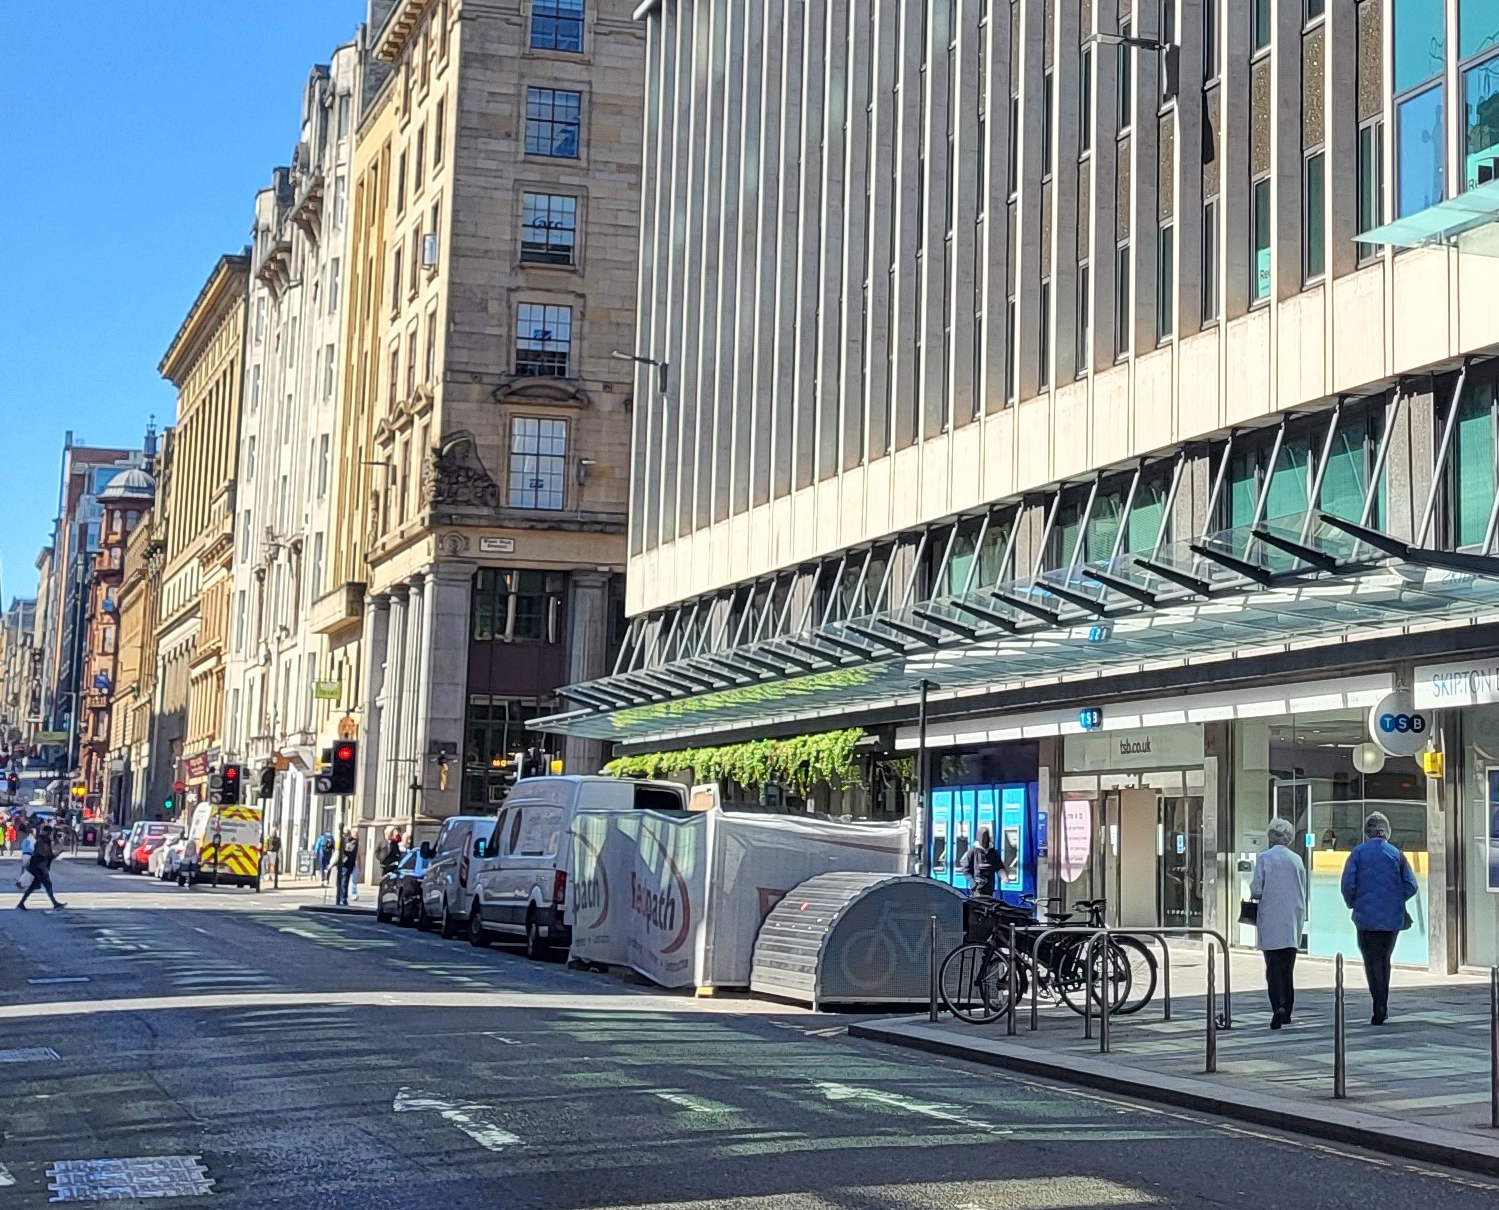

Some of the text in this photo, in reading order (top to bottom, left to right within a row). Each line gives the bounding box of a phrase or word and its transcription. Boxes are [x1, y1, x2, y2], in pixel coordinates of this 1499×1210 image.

[1432, 669, 1492, 697] SKIPTON
[1382, 716, 1424, 731] TSB
[1120, 736, 1152, 755] tsb.co.uk
